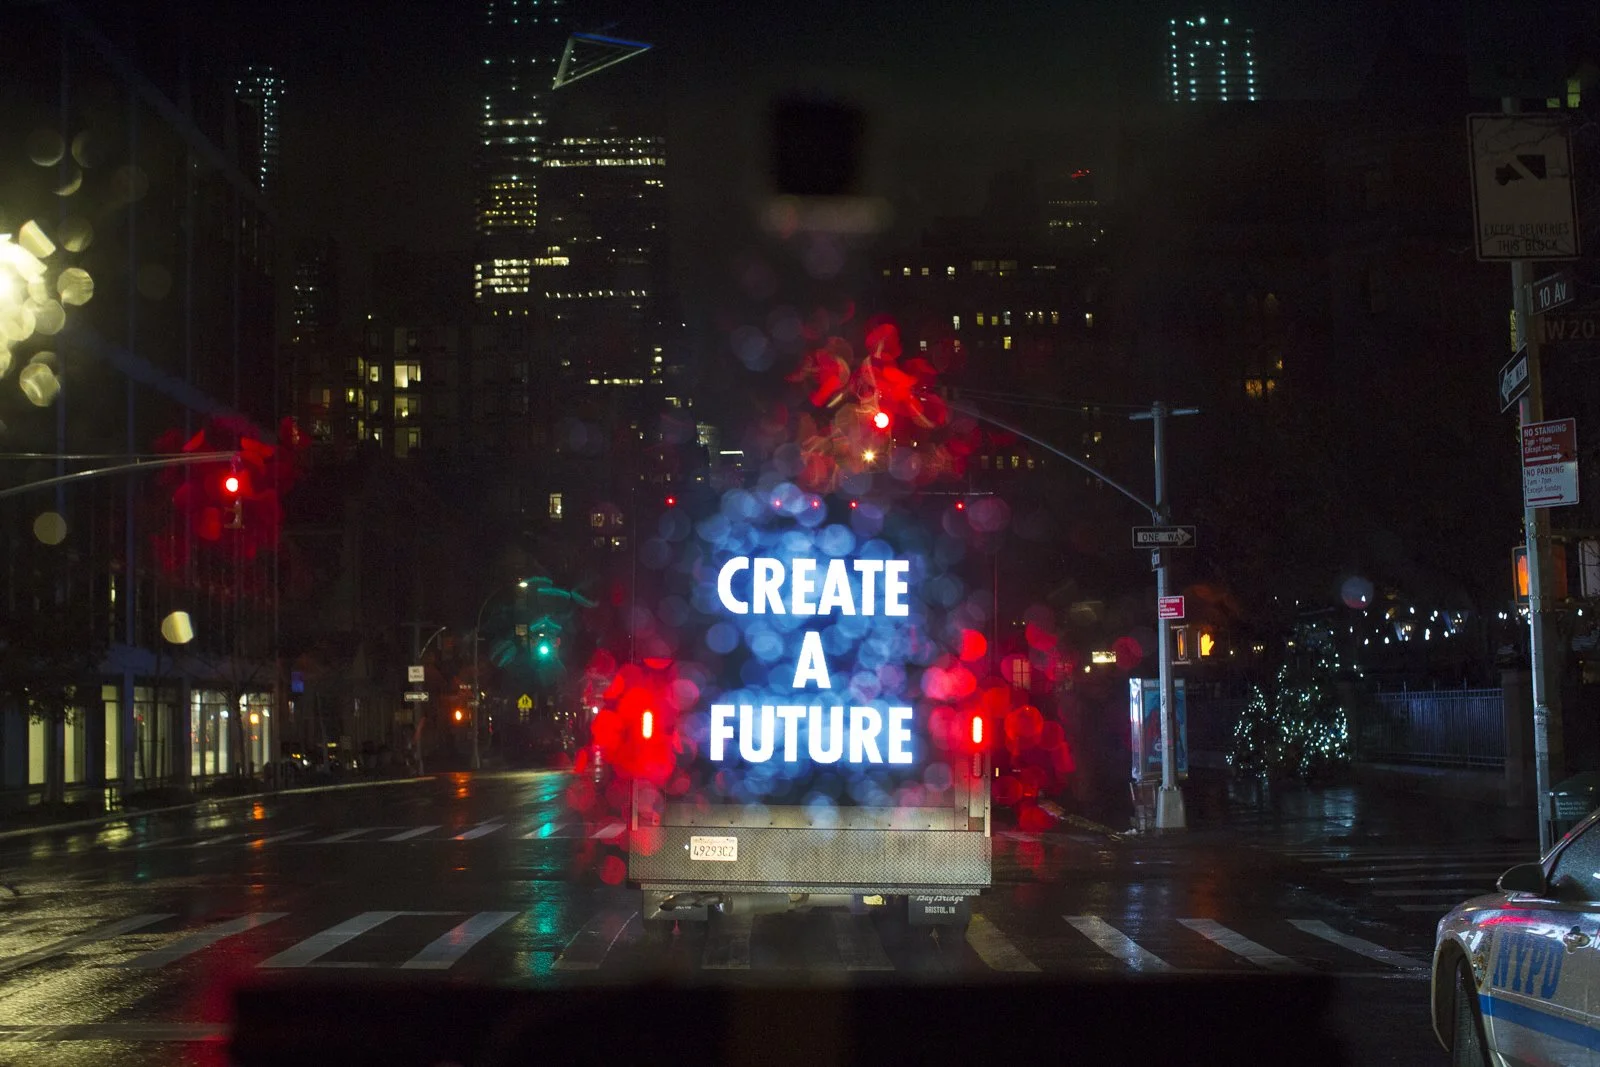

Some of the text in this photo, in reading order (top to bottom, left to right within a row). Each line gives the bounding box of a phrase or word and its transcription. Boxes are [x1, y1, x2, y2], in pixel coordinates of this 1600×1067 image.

[1484, 222, 1569, 236] EXCEPT DELIVERIES
[1496, 239, 1558, 252] THIS BLOCK
[1539, 286, 1551, 309] 10
[1524, 424, 1567, 438] NO STANDING
[1526, 465, 1564, 476] NO PARKING
[1142, 532, 1186, 541] ONE WAY
[717, 556, 909, 616] CREATE
[792, 631, 831, 688] A
[710, 704, 912, 764] FUTURE
[1492, 931, 1565, 999] NYPD
